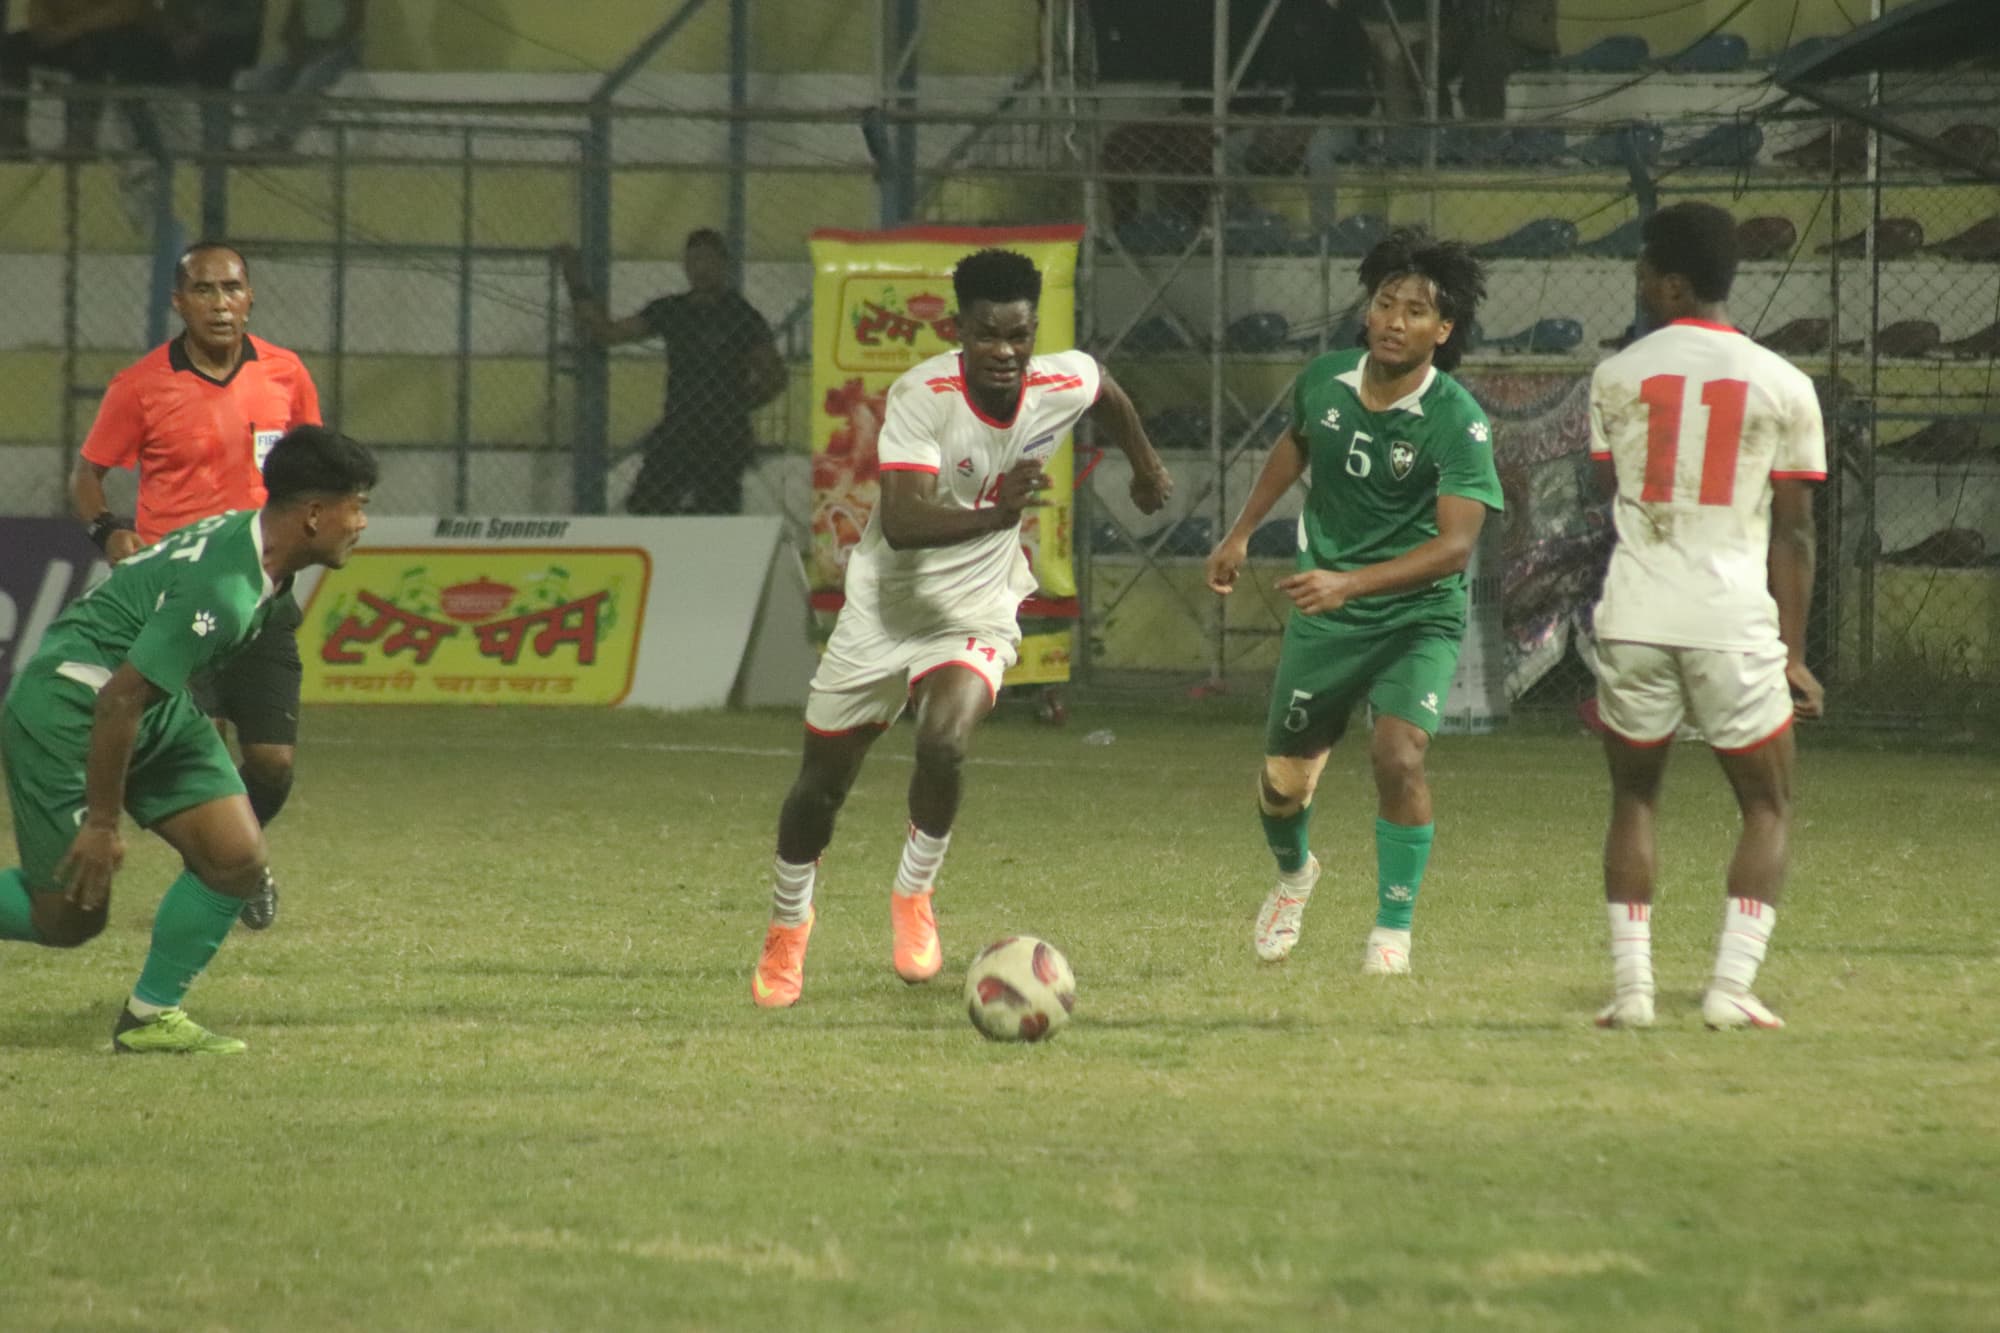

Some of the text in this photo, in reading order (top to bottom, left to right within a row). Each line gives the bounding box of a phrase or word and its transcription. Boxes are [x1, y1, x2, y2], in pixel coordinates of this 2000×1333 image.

[1344, 430, 1375, 478] 5
[1639, 373, 1749, 507] 11
[434, 517, 571, 540] Main Sponsor
[965, 637, 997, 662] 14
[1285, 689, 1312, 734] 5
